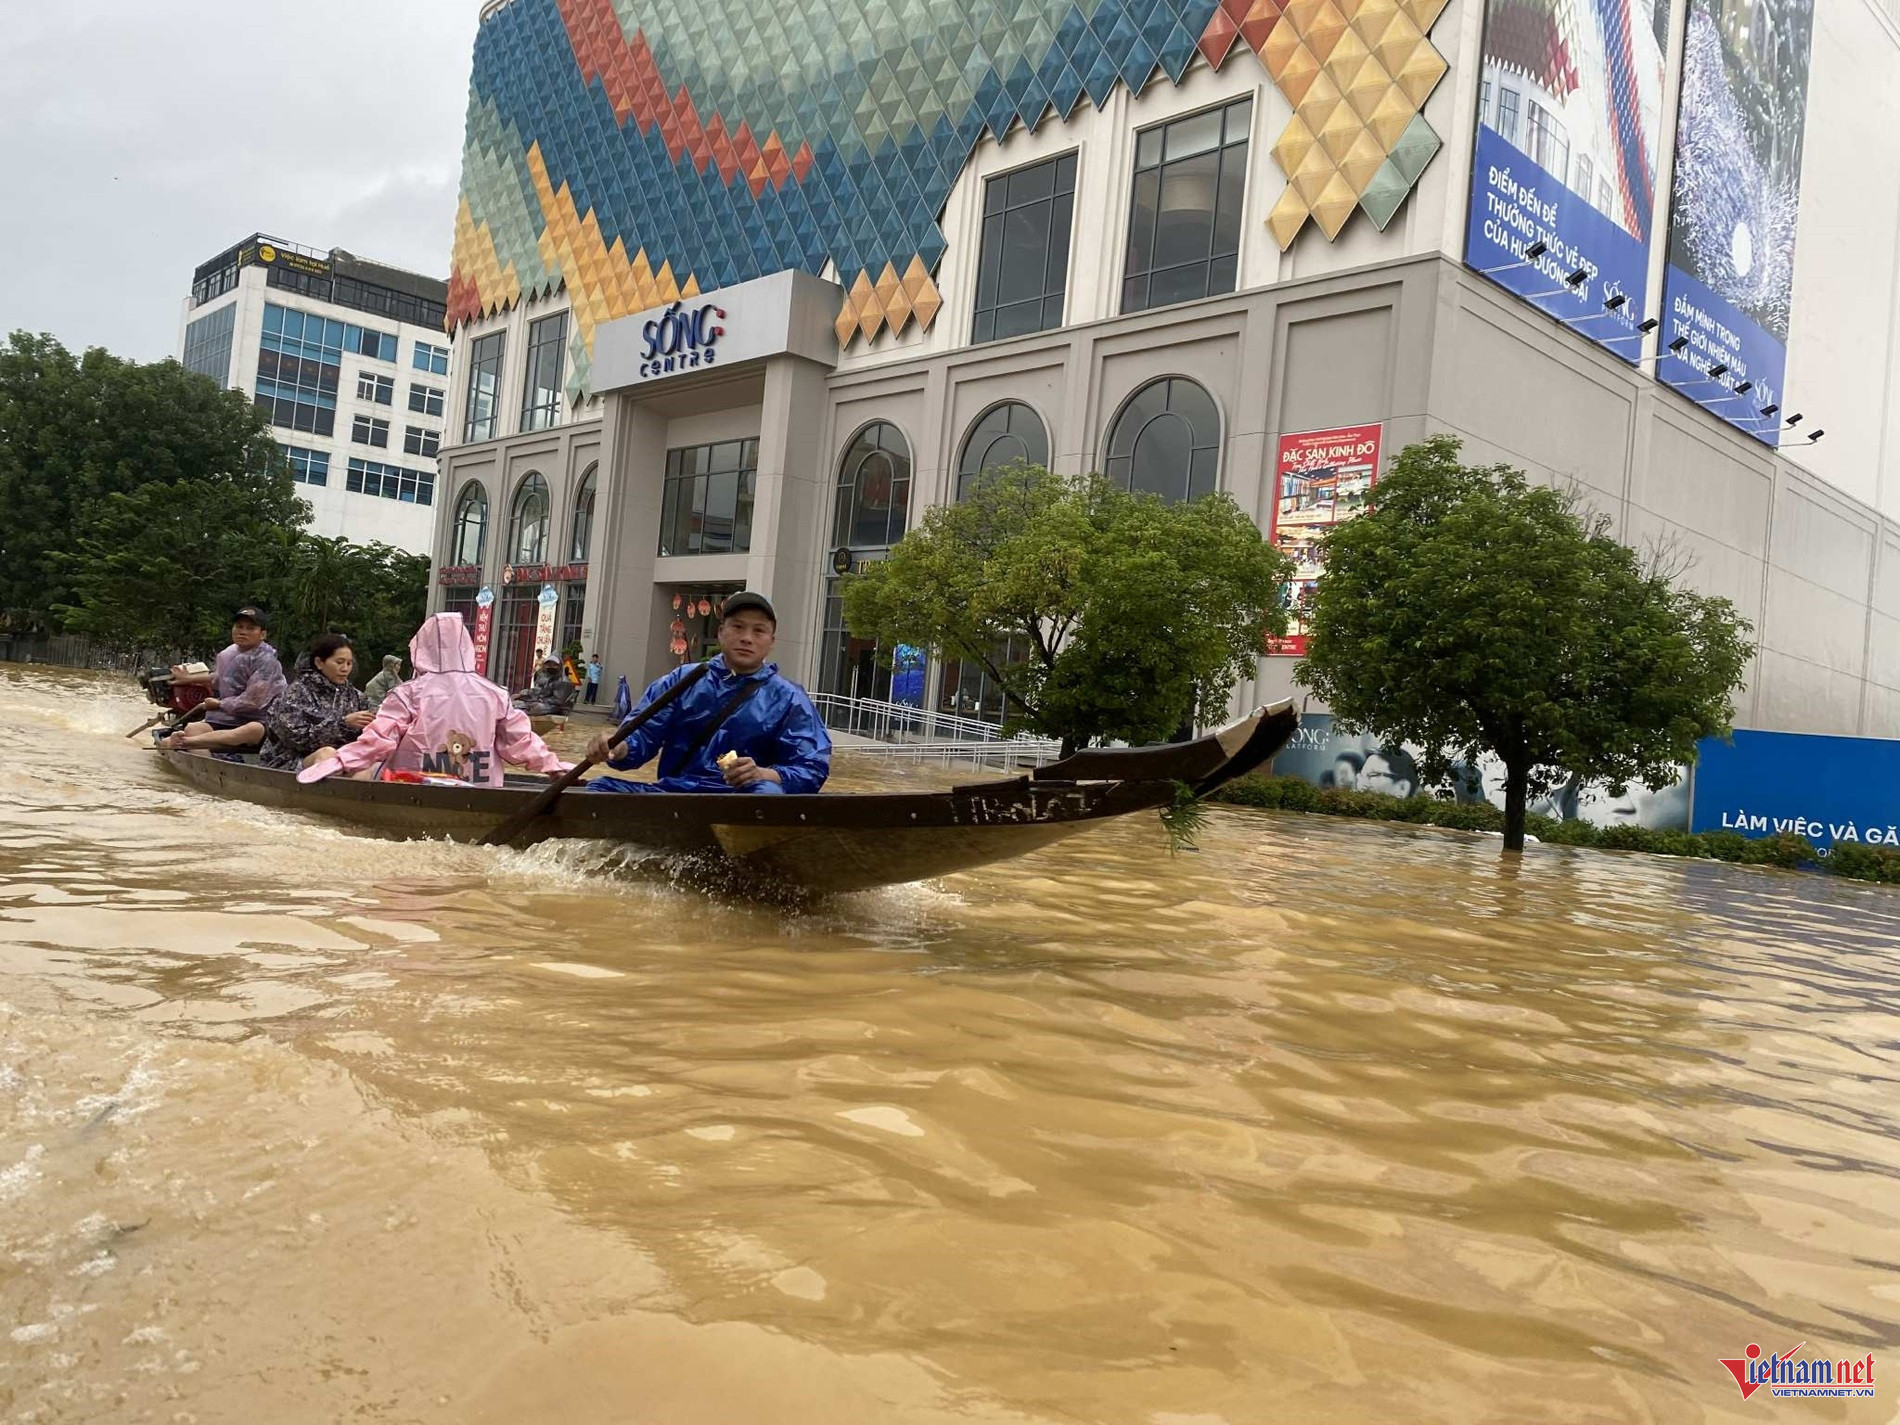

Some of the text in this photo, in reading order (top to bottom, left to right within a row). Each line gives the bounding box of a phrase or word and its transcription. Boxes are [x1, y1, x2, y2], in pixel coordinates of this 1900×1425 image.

[1489, 165, 1558, 228] ĐIỂM ĐẾN ĐỂ
[1484, 218, 1509, 250] CỦA
[1487, 192, 1535, 238] THƯỞNG
[1565, 245, 1579, 269] VẺ
[639, 301, 725, 360] SỐNG
[1716, 322, 1741, 351] TRONG
[1283, 448, 1303, 463] ĐẶC
[1305, 444, 1326, 459] SẢN
[1328, 444, 1354, 458] KINH
[1357, 440, 1375, 455] ĐÔ
[1721, 809, 1768, 832] LÀM
[1829, 820, 1860, 842] VÀ
